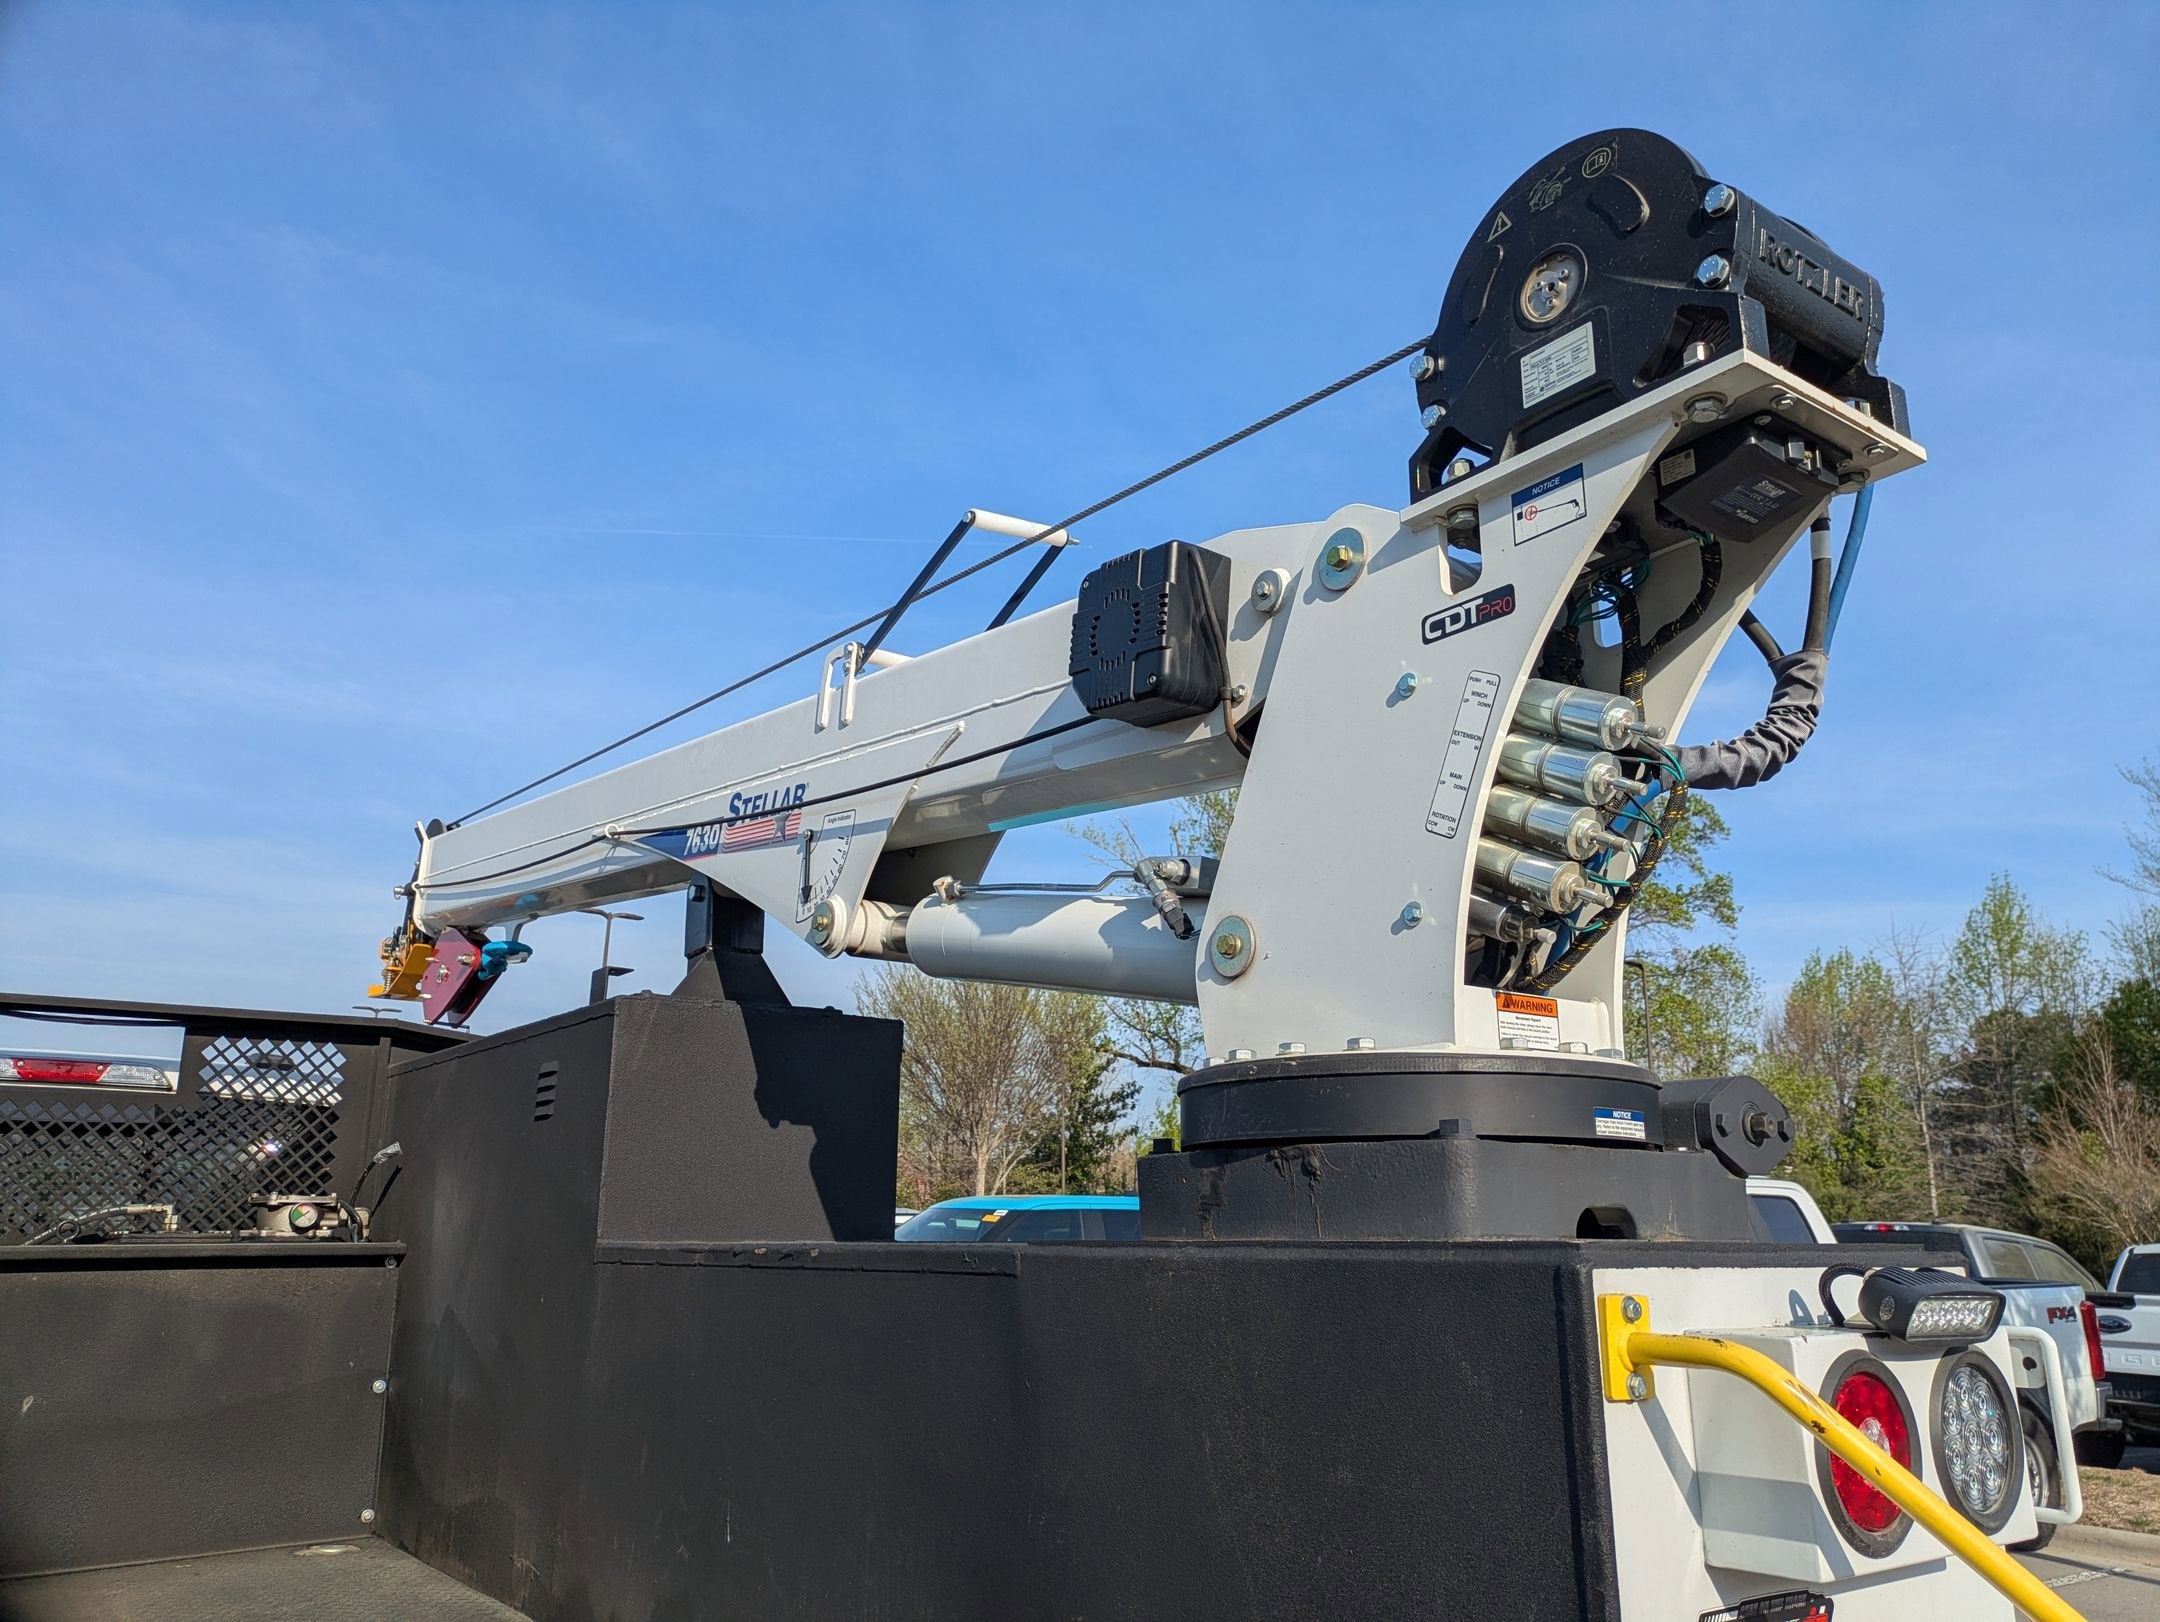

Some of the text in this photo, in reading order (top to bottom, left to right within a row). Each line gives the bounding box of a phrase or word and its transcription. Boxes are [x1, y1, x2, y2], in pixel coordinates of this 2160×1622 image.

[1759, 227, 1864, 321] ROTZLER
[1531, 476, 1561, 496] NOTICE
[1469, 676, 1497, 687] PUSH PULL
[1471, 690, 1489, 700] WINCH
[1462, 697, 1491, 709] UP DOWN
[1453, 729, 1482, 742] EXTENSION
[1451, 739, 1461, 747] OUT
[1449, 771, 1463, 781] MAIN
[1453, 783, 1467, 792] DOWN
[727, 782, 808, 828] STELLAR
[1431, 811, 1457, 824] ROTATION
[683, 824, 720, 857] 7630
[1510, 999, 1553, 1014] WARNING
[1612, 1110, 1632, 1120] NOTICE
